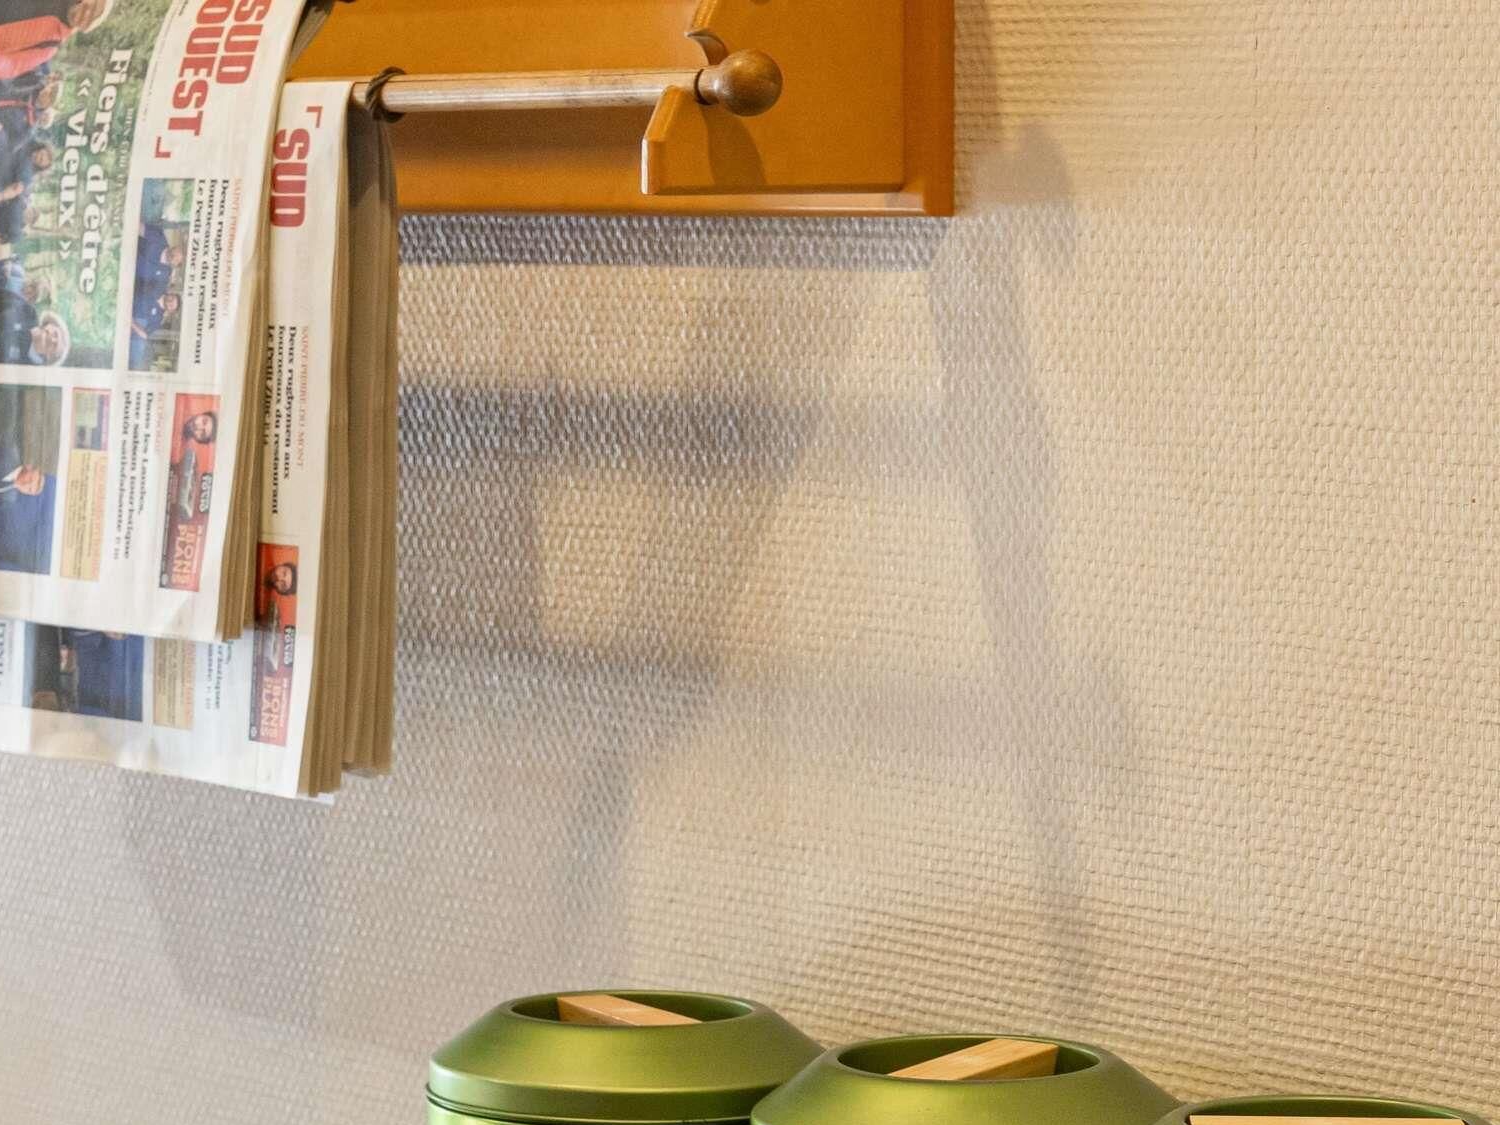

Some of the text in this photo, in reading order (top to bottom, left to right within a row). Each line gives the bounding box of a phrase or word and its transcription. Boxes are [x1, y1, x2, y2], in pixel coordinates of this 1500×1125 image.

[168, 0, 234, 136] OUEST
[216, 0, 272, 84] SUD
[58, 108, 87, 226] vieux
[79, 48, 133, 293] Fiers d'être
[219, 179, 229, 217] Deux
[270, 128, 312, 227] SUD
[201, 260, 209, 280] du
[209, 303, 217, 329] aux
[288, 326, 297, 364] Deux
[263, 385, 273, 419] Zinc
[266, 347, 274, 381] Petit
[272, 326, 285, 514] fourneaux du restaurant
[284, 369, 294, 448] rugbymen
